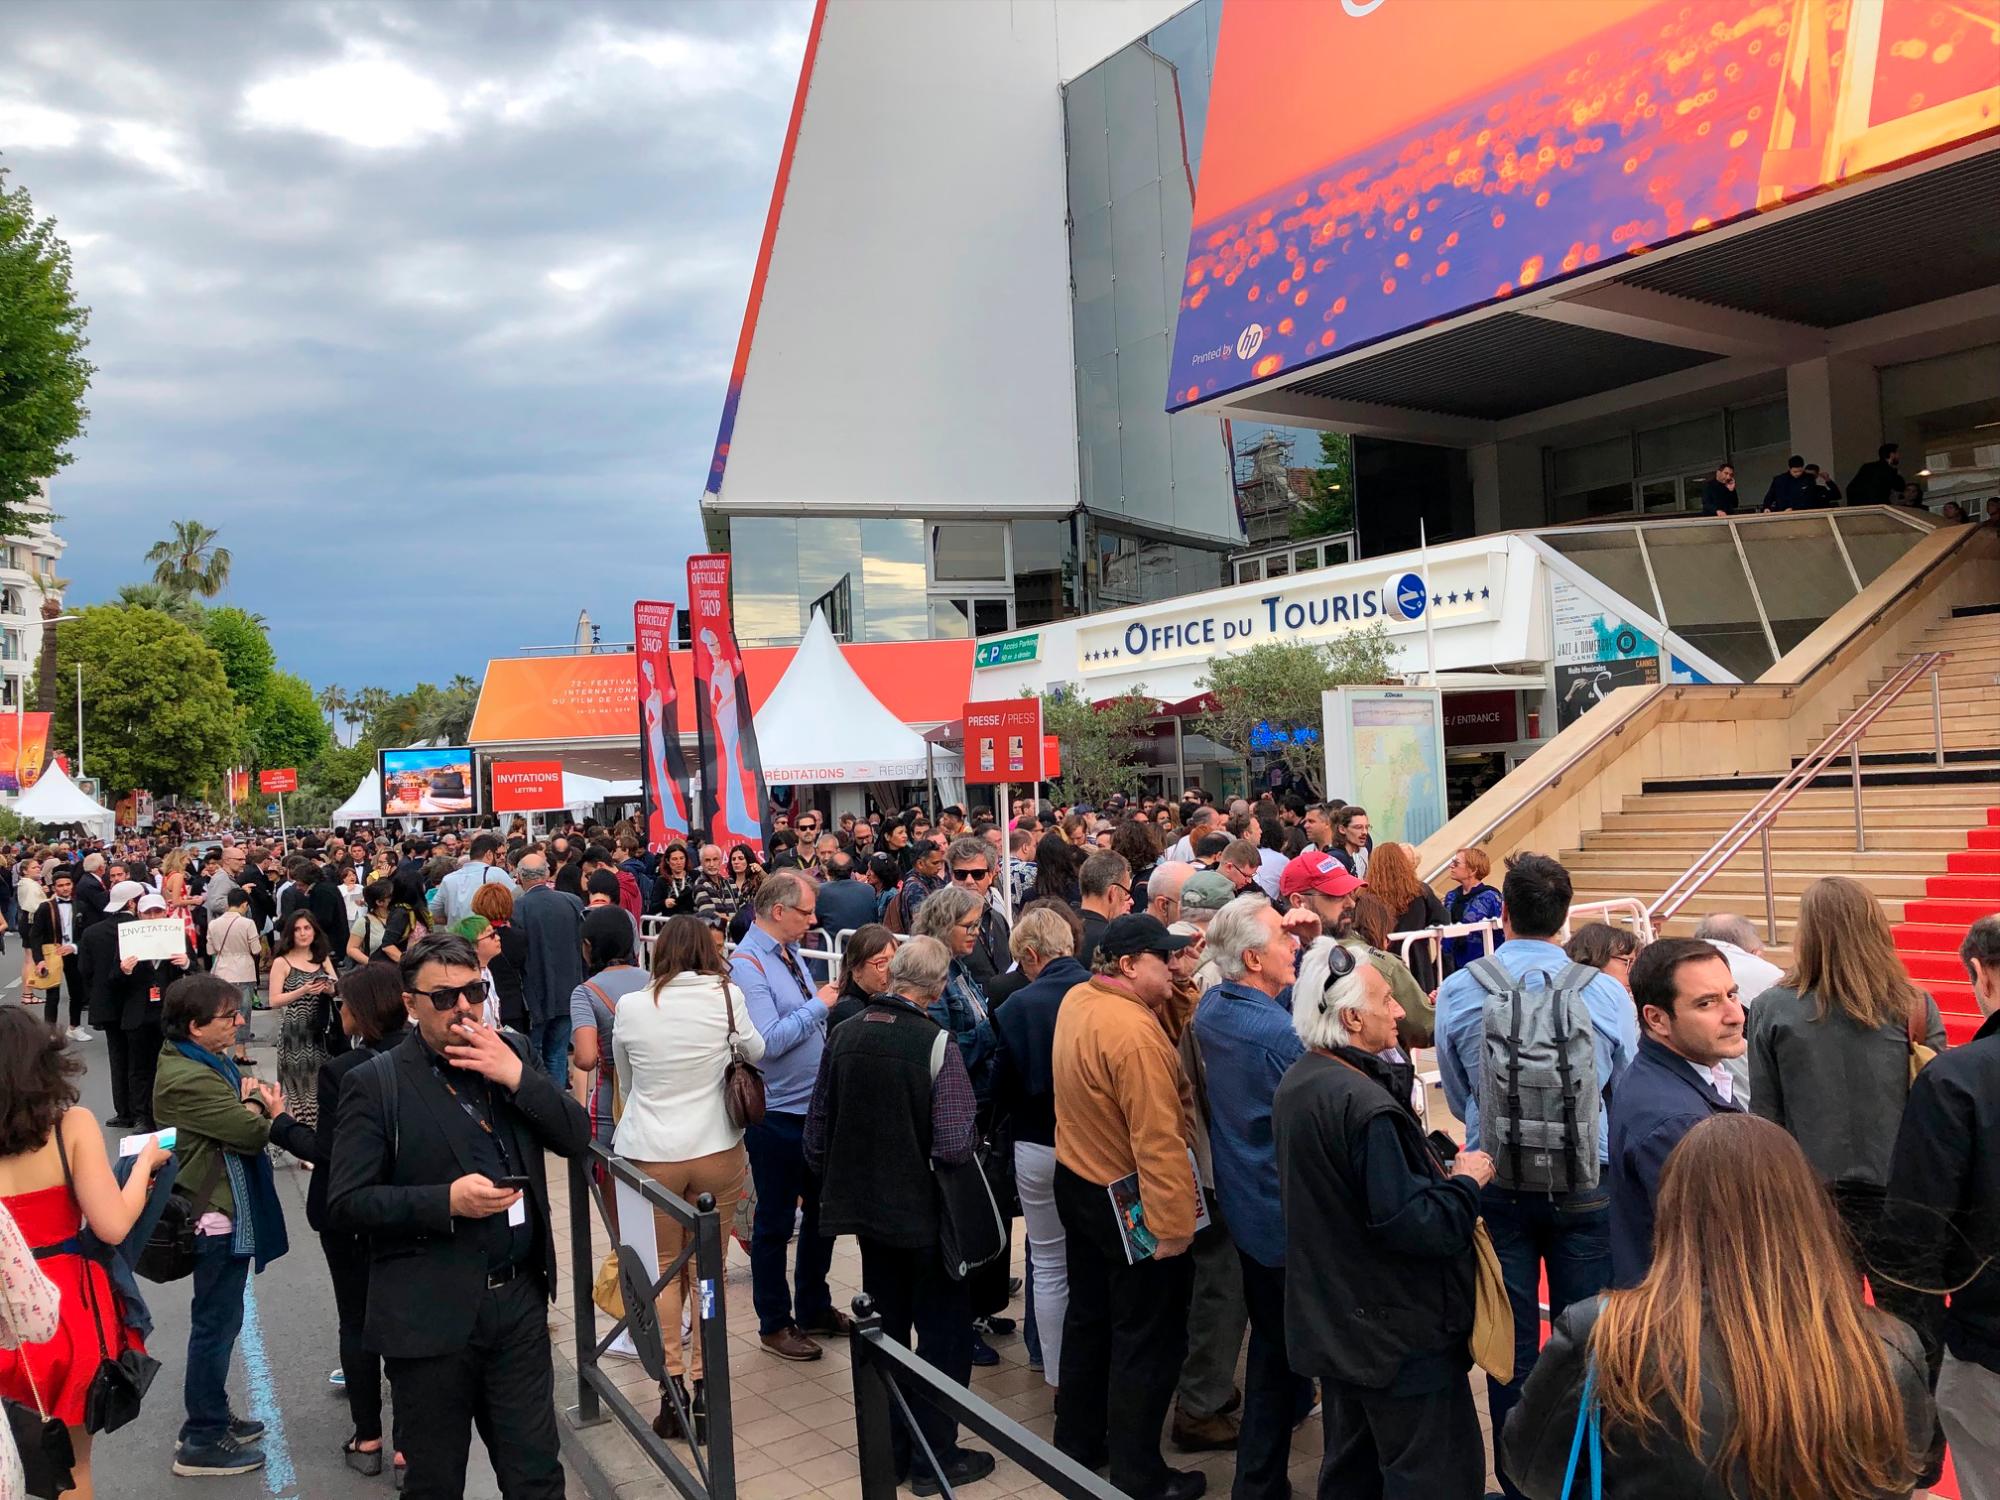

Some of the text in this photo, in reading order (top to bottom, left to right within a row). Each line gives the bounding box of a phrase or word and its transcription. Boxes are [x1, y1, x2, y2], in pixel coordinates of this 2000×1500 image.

[1192, 323, 1263, 366] Printed by hp
[690, 558, 725, 570] LA BOUTIQUE
[691, 571, 725, 585] OFFICIELLE
[637, 604, 670, 615] LA BOUTIQUE
[701, 599, 721, 616] SHOP
[637, 614, 668, 627] OFFICIELLE
[1124, 589, 1388, 655] OFFICE DU TOURIS
[642, 637, 662, 652] SHOP
[990, 646, 1000, 662] P
[1635, 659, 1657, 668] CANNES
[591, 678, 638, 687] FESTIVAL
[563, 687, 638, 696] INTERNATIONA
[968, 714, 1000, 727] PRESSE
[1007, 712, 1036, 725] PRESS
[1457, 711, 1500, 725] ENTRANCE
[497, 773, 559, 784] INVITATIONS
[764, 768, 845, 781] RÉDITATIONS
[514, 786, 537, 794] LETTRE
[121, 925, 182, 937] INVITATION
